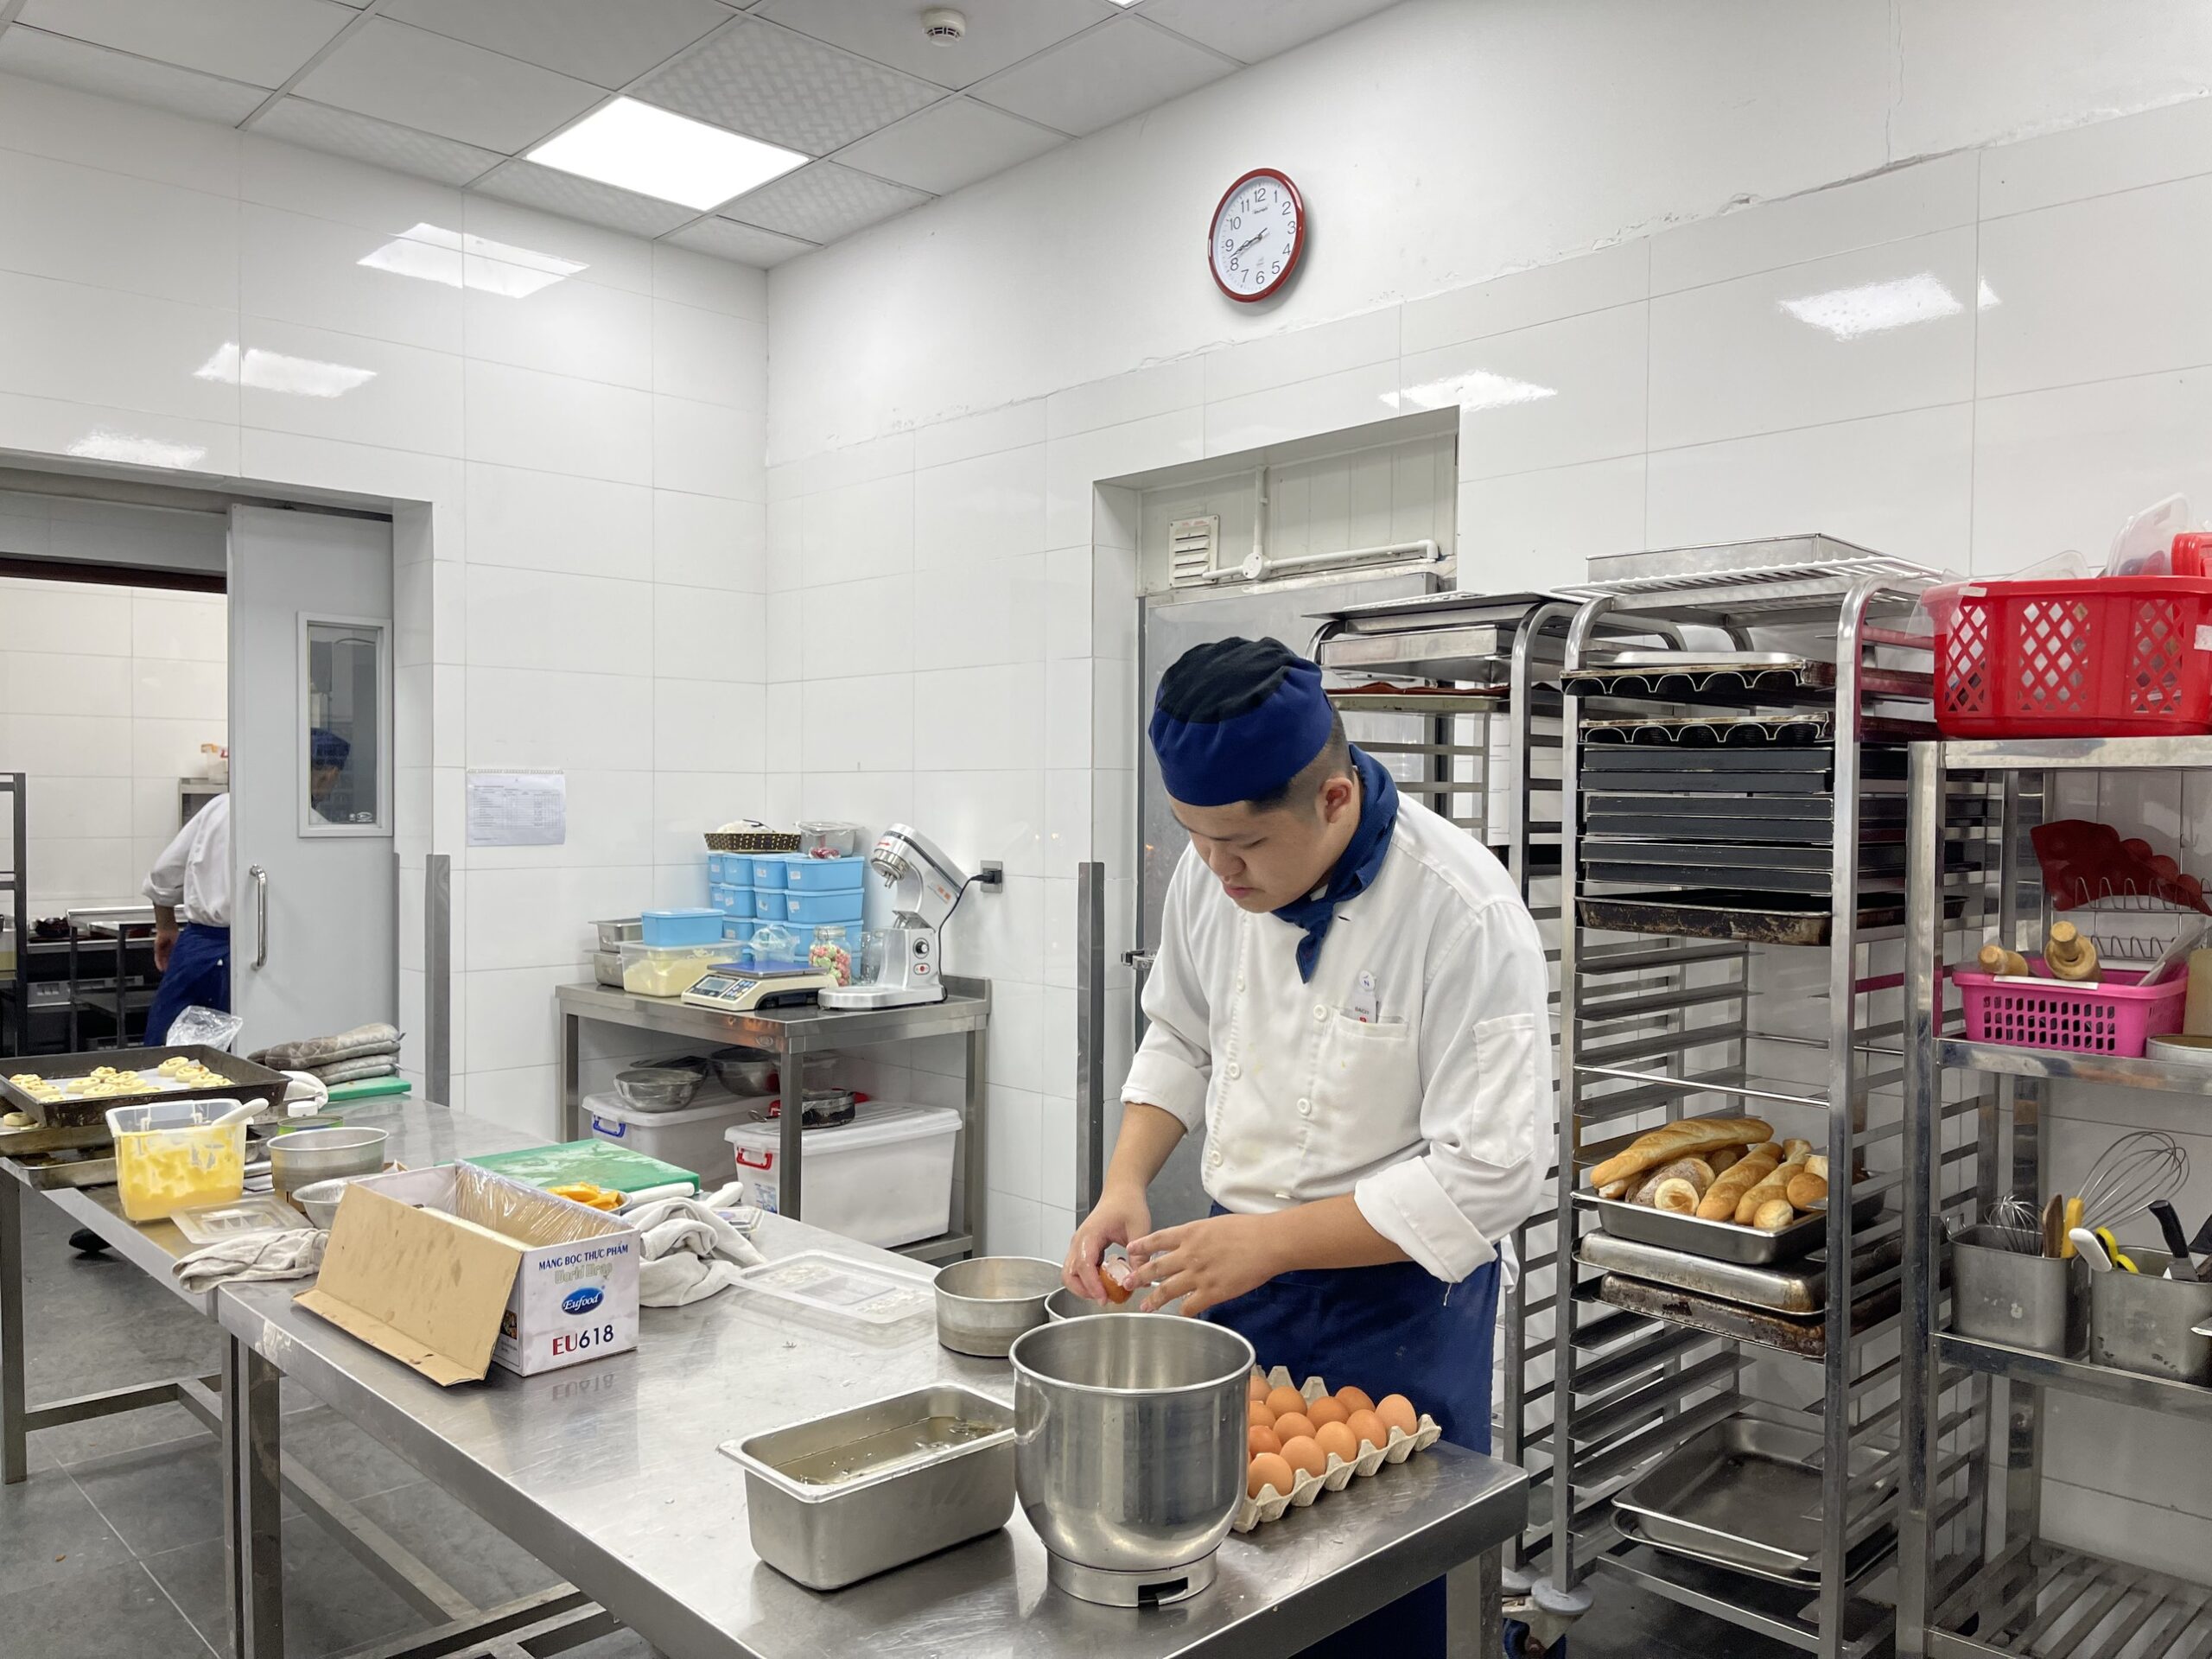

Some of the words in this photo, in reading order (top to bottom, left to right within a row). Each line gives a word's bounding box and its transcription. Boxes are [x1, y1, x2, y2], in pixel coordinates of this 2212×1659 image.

[1255, 188, 1266, 202] 12
[1241, 199, 1249, 213] 11
[1282, 201, 1291, 215] 2
[1230, 216, 1242, 231] 10
[1287, 220, 1296, 234] 3
[1225, 238, 1234, 251] 9
[1282, 243, 1291, 256] 4
[1230, 257, 1239, 270] 8
[1271, 260, 1281, 274] 5
[1241, 269, 1249, 283] 7
[1255, 270, 1265, 284] 6
[564, 1254, 582, 1267] BỌC
[563, 1292, 602, 1311] Eufood
[553, 1325, 614, 1356] EU618
